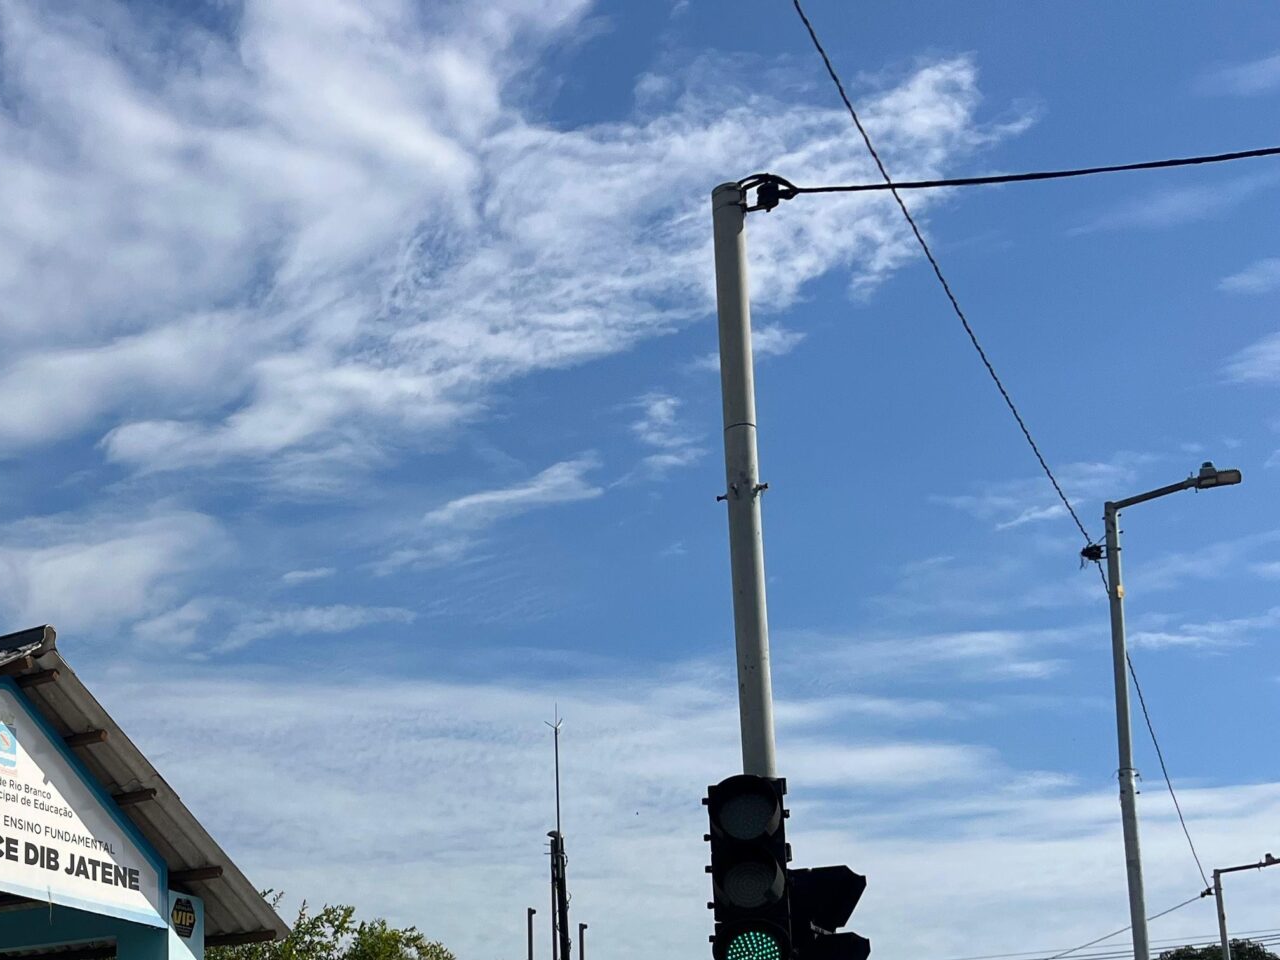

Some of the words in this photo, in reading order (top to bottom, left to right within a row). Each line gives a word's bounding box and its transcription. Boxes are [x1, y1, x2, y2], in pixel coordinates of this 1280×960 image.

[9, 778, 23, 791] Rio
[24, 784, 52, 800] Branco
[20, 795, 32, 807] de
[33, 799, 73, 819] Educação
[3, 815, 42, 835] ENSINO
[44, 826, 116, 855] FUNDAMENTAL
[24, 841, 60, 872] DIB
[64, 853, 140, 891] JATENE
[172, 909, 195, 926] VIP
